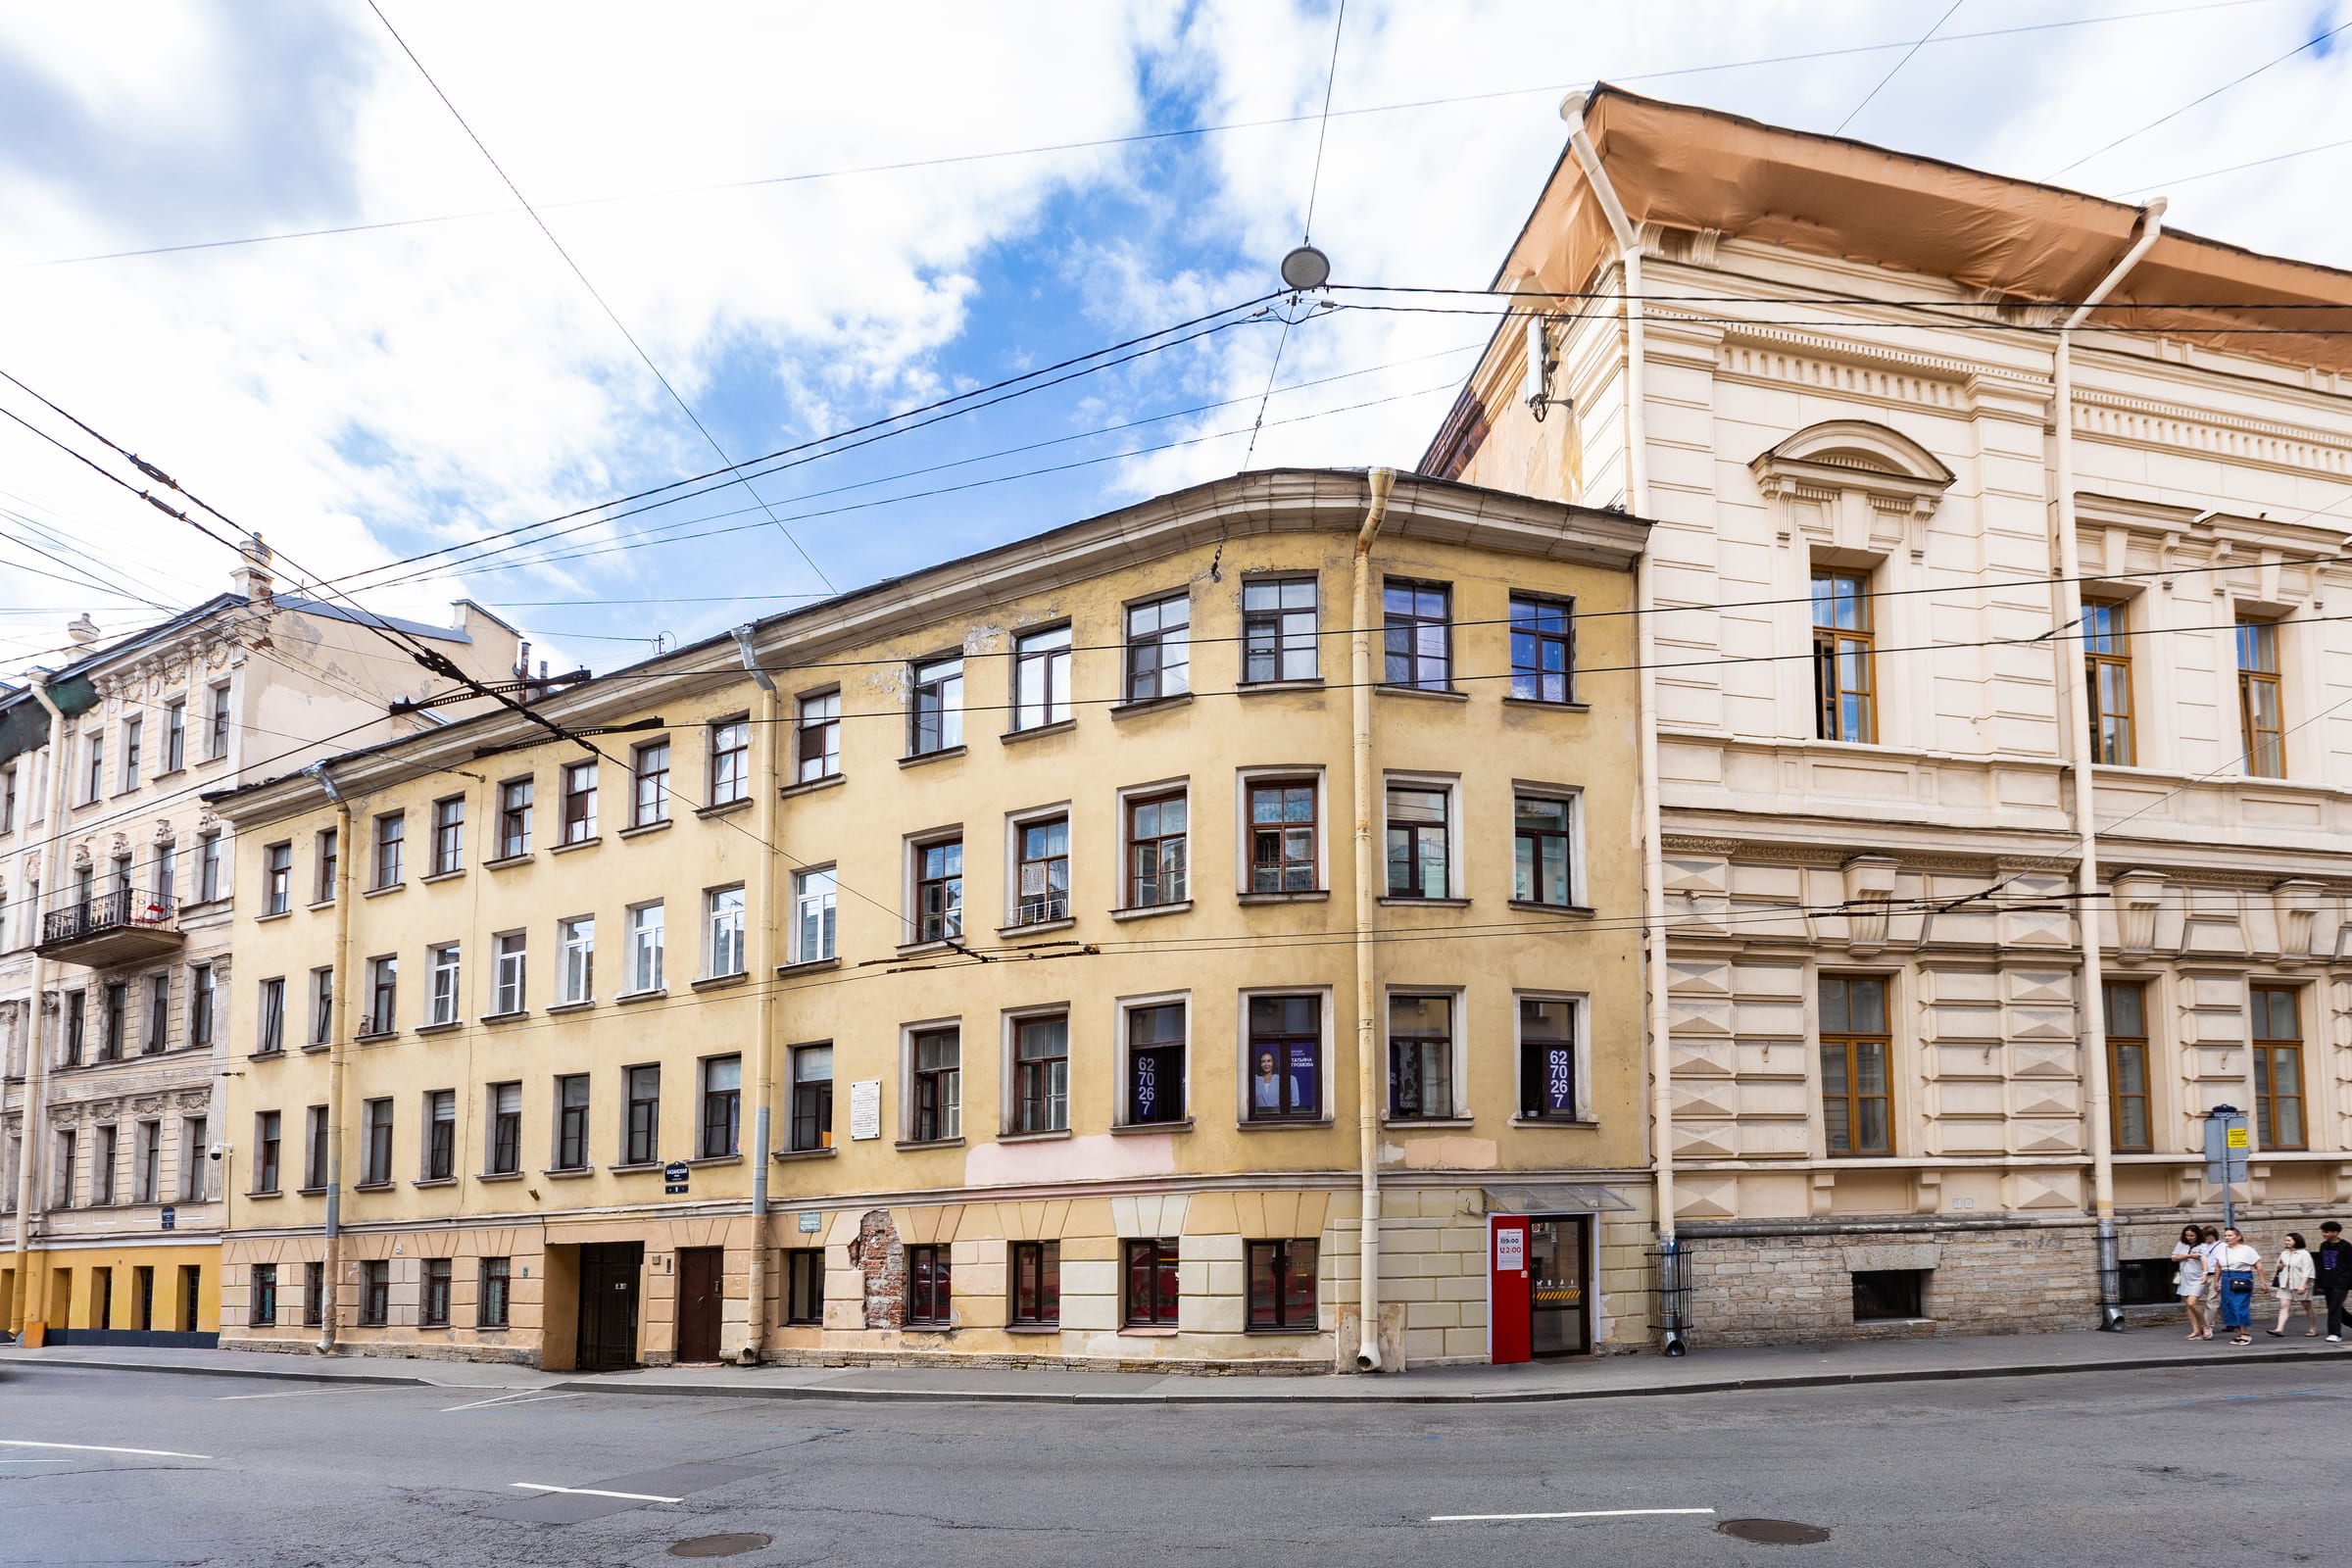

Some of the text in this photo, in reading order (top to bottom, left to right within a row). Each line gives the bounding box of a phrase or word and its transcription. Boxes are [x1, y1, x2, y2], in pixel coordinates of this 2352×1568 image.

[1139, 1057, 1154, 1071] 62
[1550, 1051, 1567, 1064] 62
[1550, 1065, 1567, 1078] 70
[1139, 1072, 1154, 1086] 70
[1550, 1080, 1567, 1093] 26
[1139, 1087, 1154, 1101] 26
[1554, 1094, 1563, 1107] 7
[1142, 1102, 1151, 1114] 7
